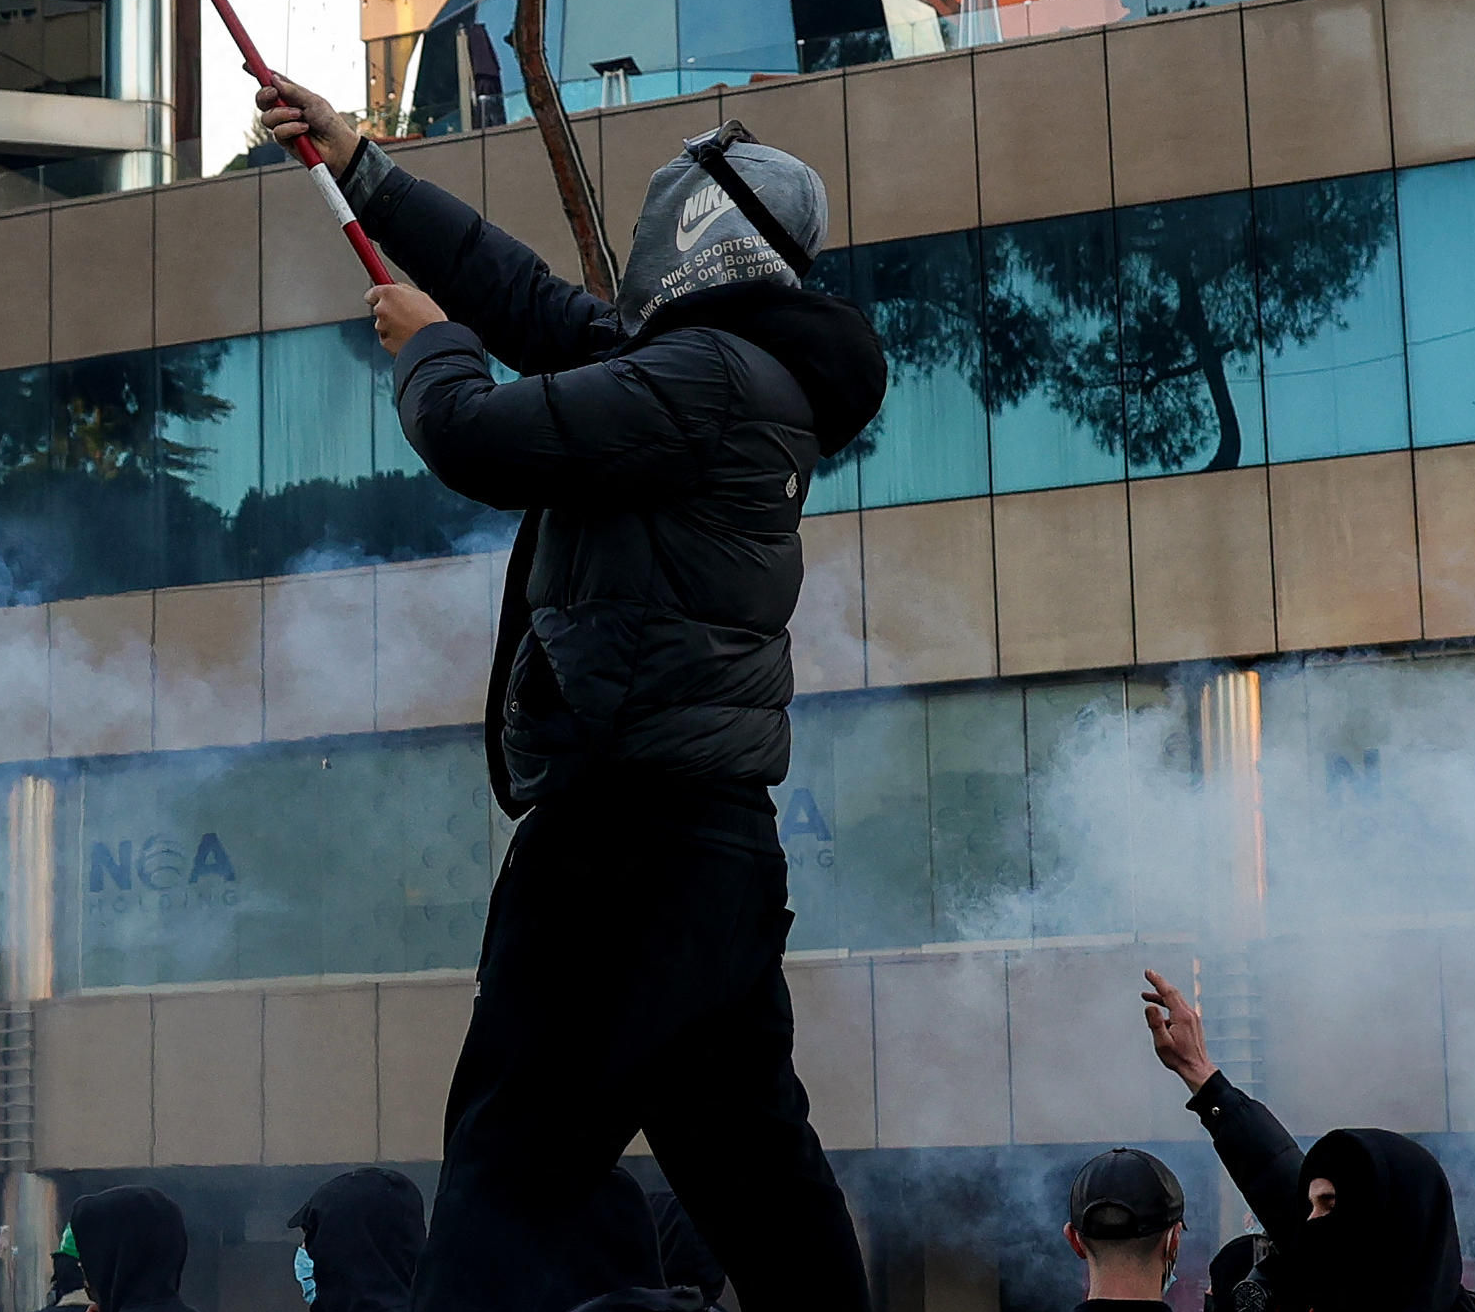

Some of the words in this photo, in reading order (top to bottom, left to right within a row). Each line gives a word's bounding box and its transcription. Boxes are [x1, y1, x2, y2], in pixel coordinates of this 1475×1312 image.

[661, 261, 693, 289] NIKE
[694, 235, 770, 267] SPORTSWE
[697, 262, 723, 281] One
